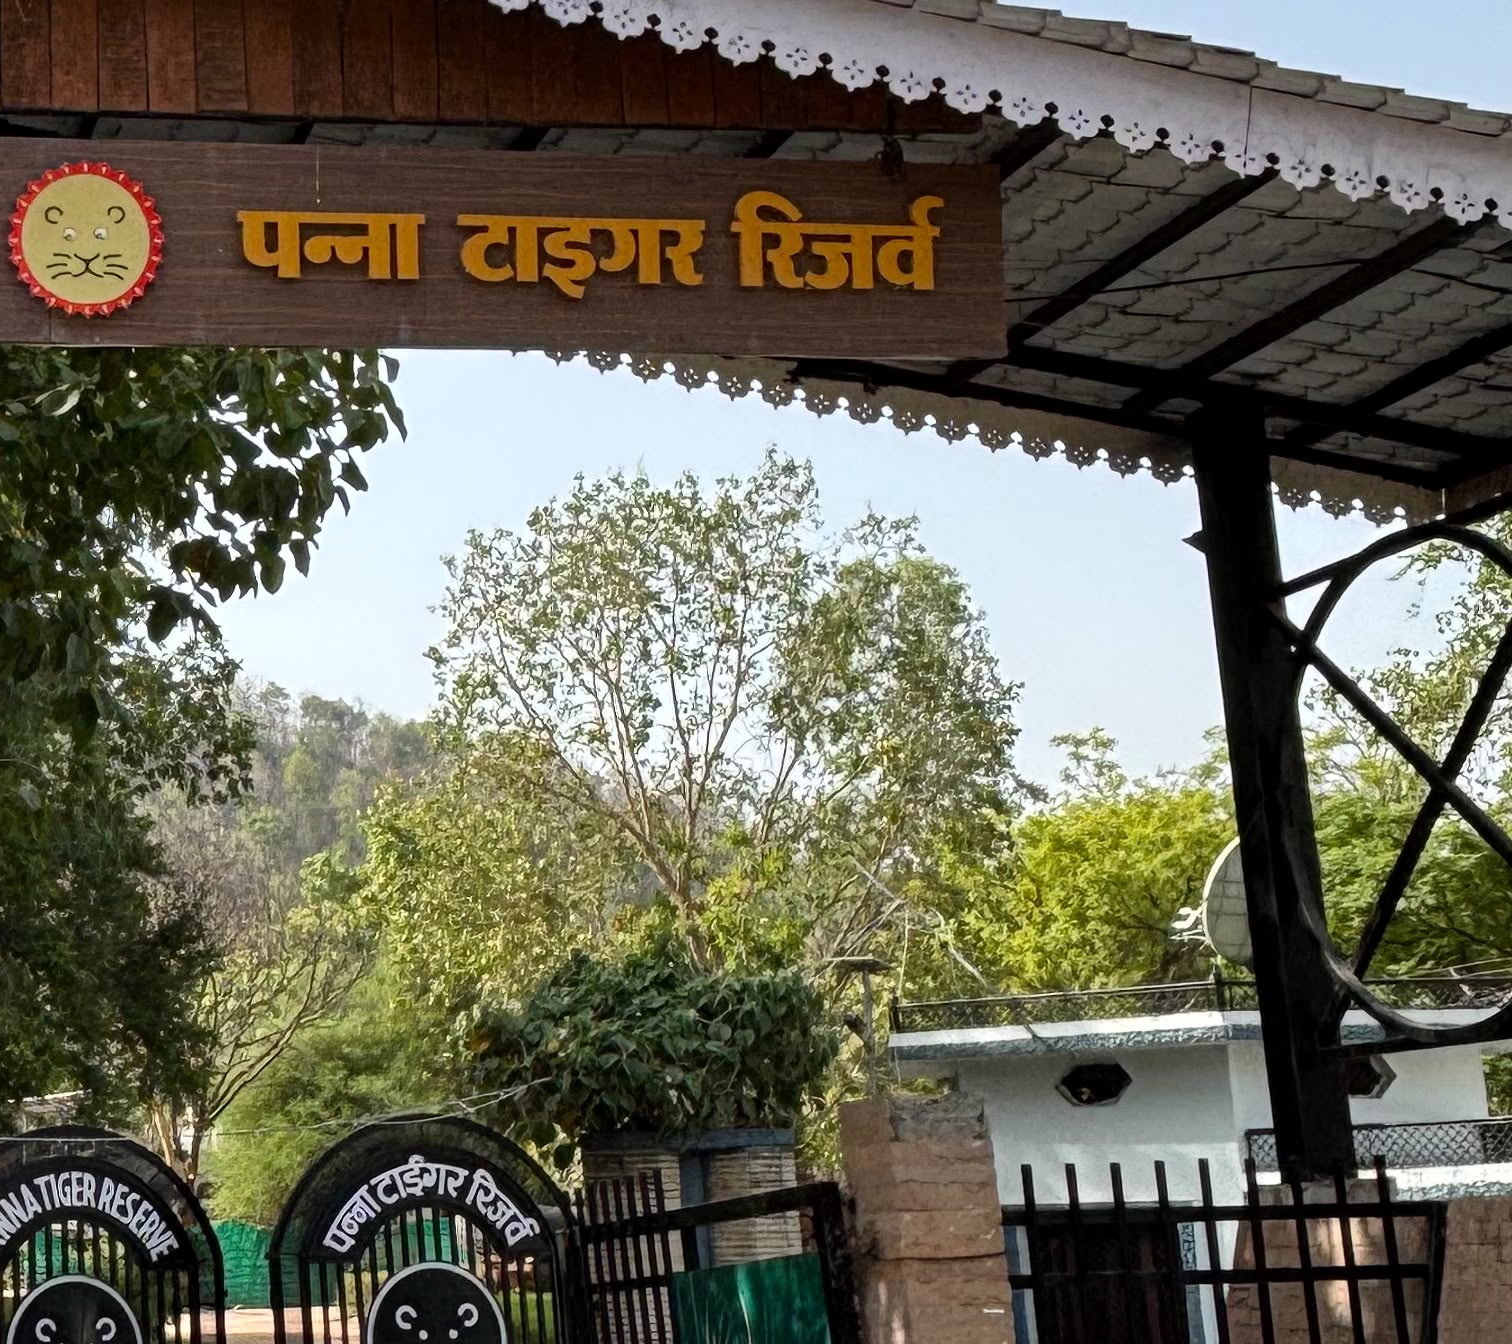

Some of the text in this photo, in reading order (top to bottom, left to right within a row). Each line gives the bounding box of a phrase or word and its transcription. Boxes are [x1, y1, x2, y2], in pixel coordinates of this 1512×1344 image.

[237, 190, 944, 299] पन्ना टाइगर रिजर्व
[33, 1171, 96, 1211] TIGER
[97, 1176, 180, 1262] RESERVE
[465, 1168, 541, 1246] रिजर्व
